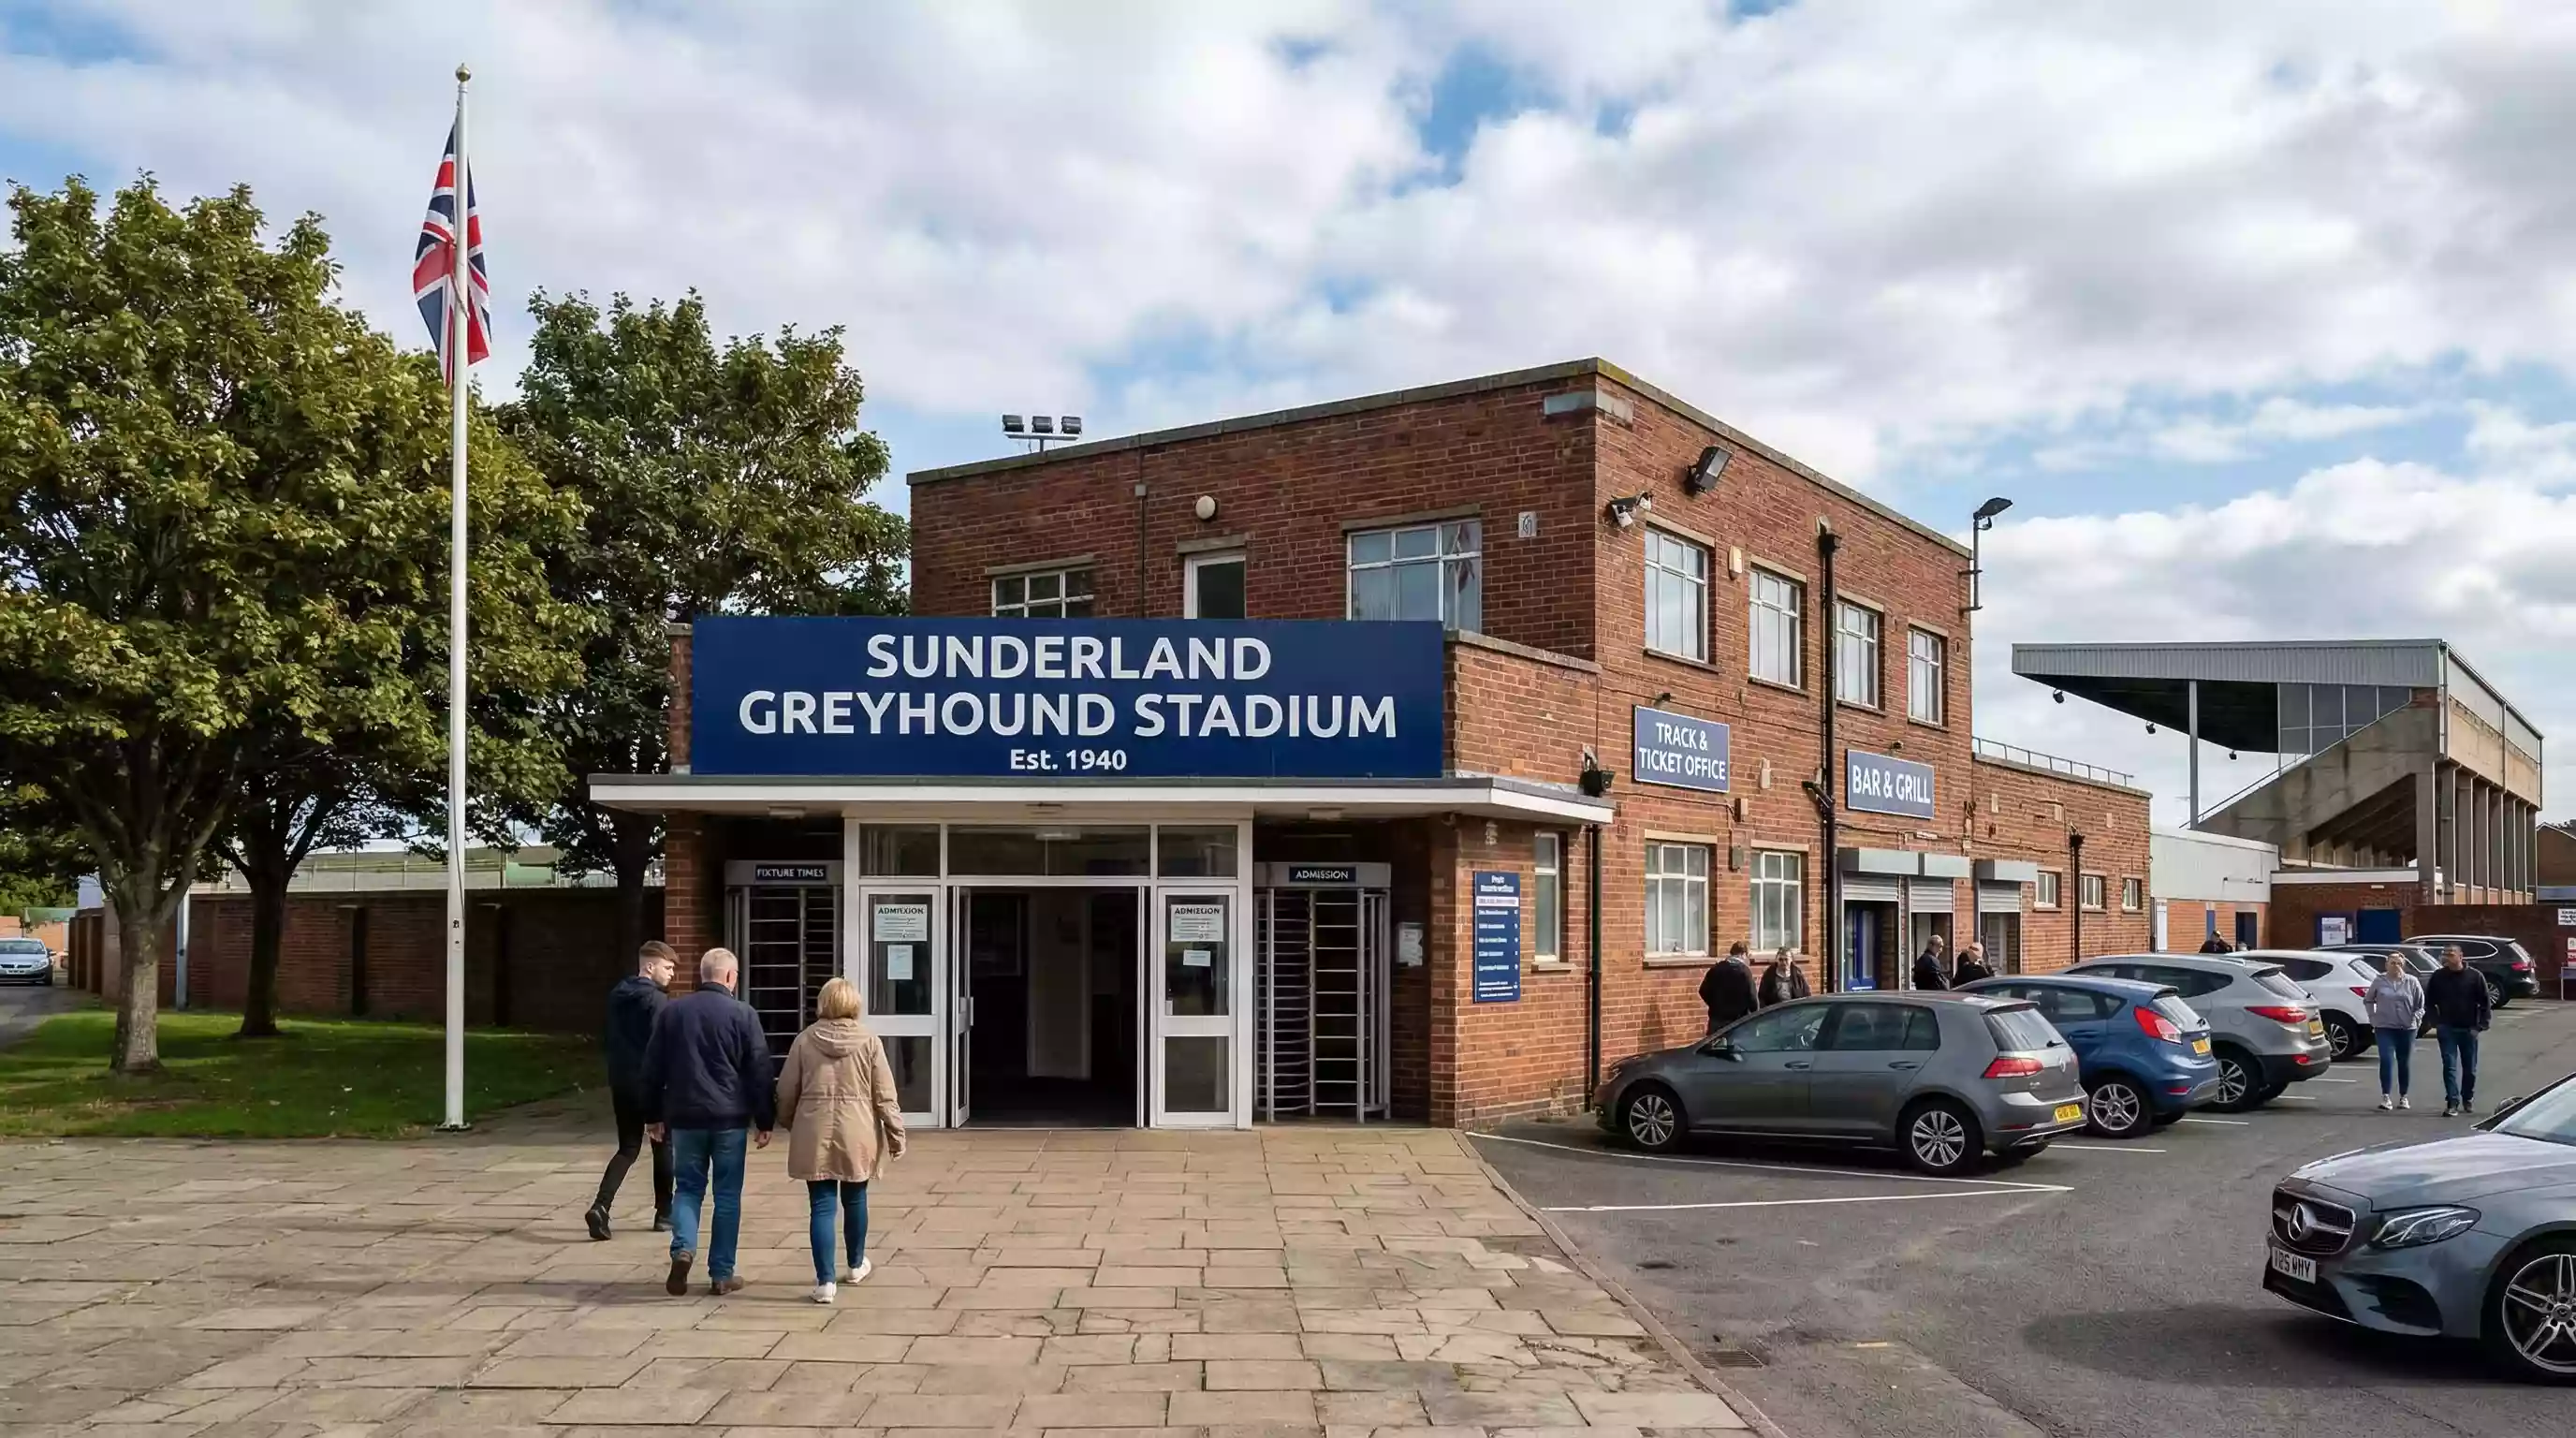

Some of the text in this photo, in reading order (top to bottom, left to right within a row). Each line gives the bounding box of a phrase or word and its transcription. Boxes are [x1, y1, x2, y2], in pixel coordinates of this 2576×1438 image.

[866, 635, 1271, 681] SUNDERLAND
[739, 691, 1397, 738] GREYHOUND STADIUM
[1655, 722, 1708, 750] TRACK &
[1010, 749, 1127, 770] Est. 1940
[1638, 746, 1726, 781] TICKET OFFICE
[1852, 764, 1931, 804] BAR & GRILL
[757, 868, 824, 877] FIXTURE TIMES
[1295, 870, 1349, 879] ADMISSION
